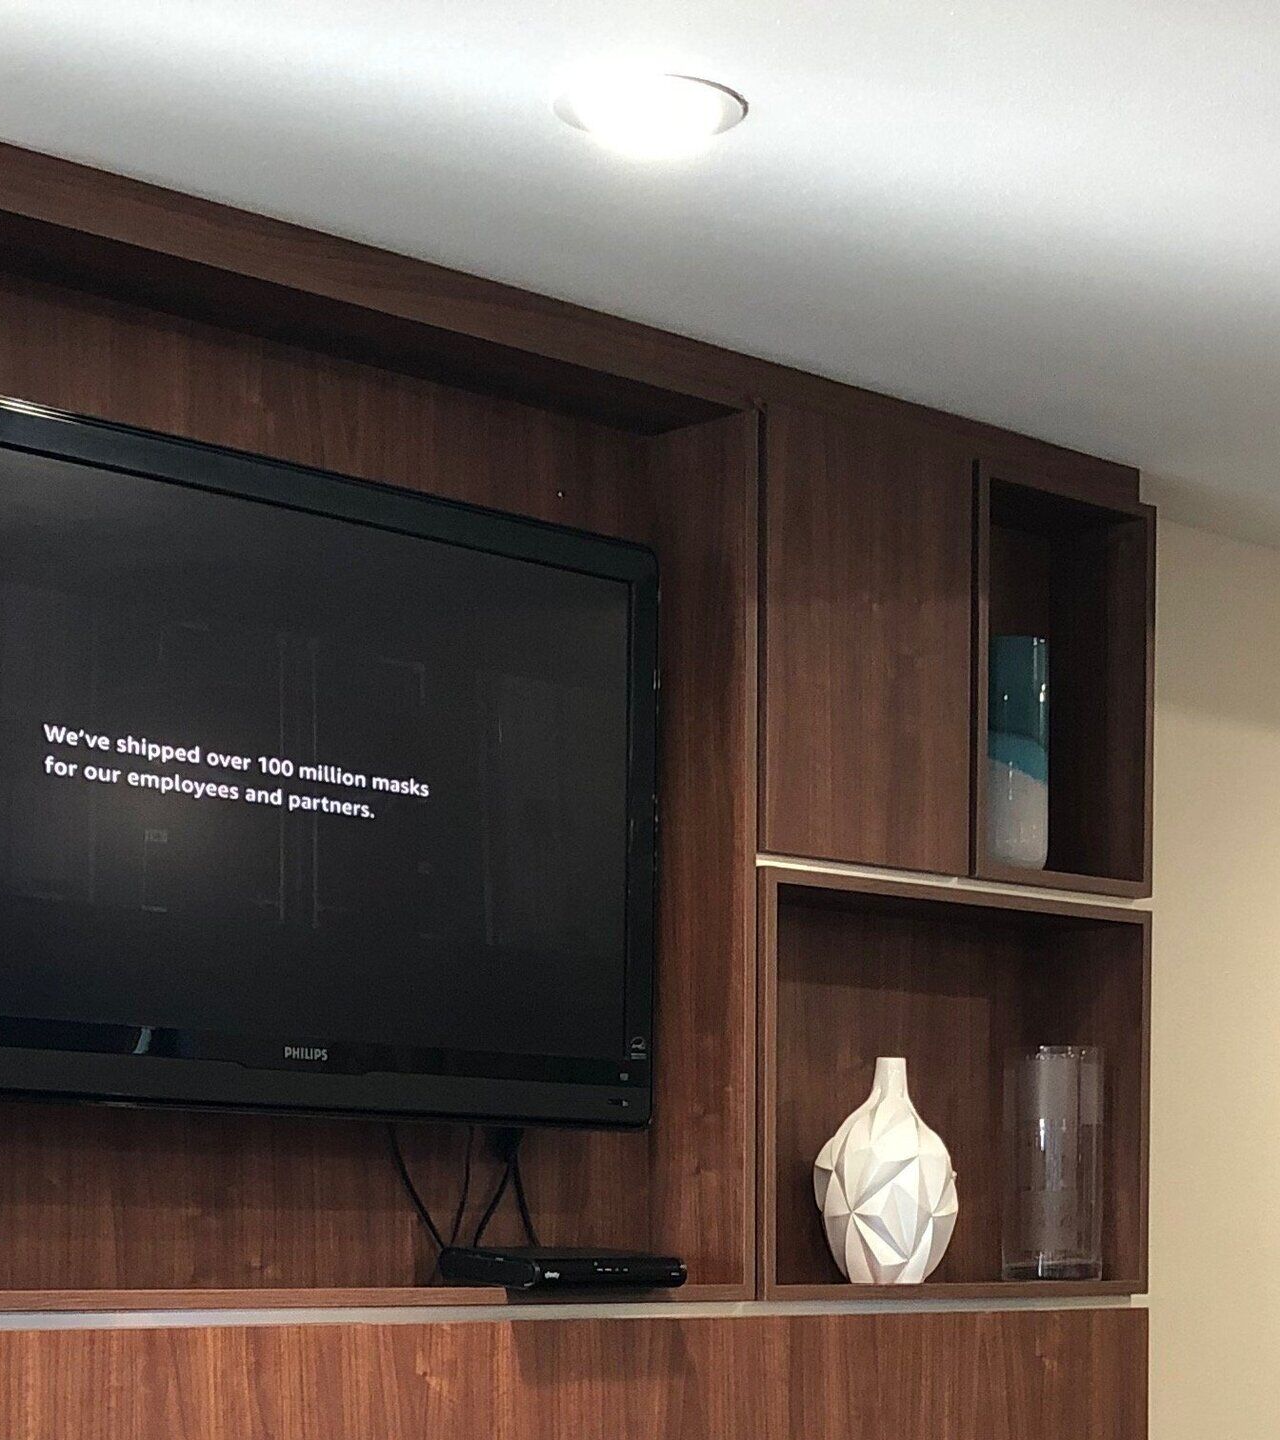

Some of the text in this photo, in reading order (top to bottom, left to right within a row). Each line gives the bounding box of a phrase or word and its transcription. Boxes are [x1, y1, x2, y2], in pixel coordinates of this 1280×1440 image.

[43, 723, 430, 799] We've shipped over 100 million masks
[44, 755, 375, 820] for our employees and partners.
[284, 1046, 328, 1061] PHILIPS
